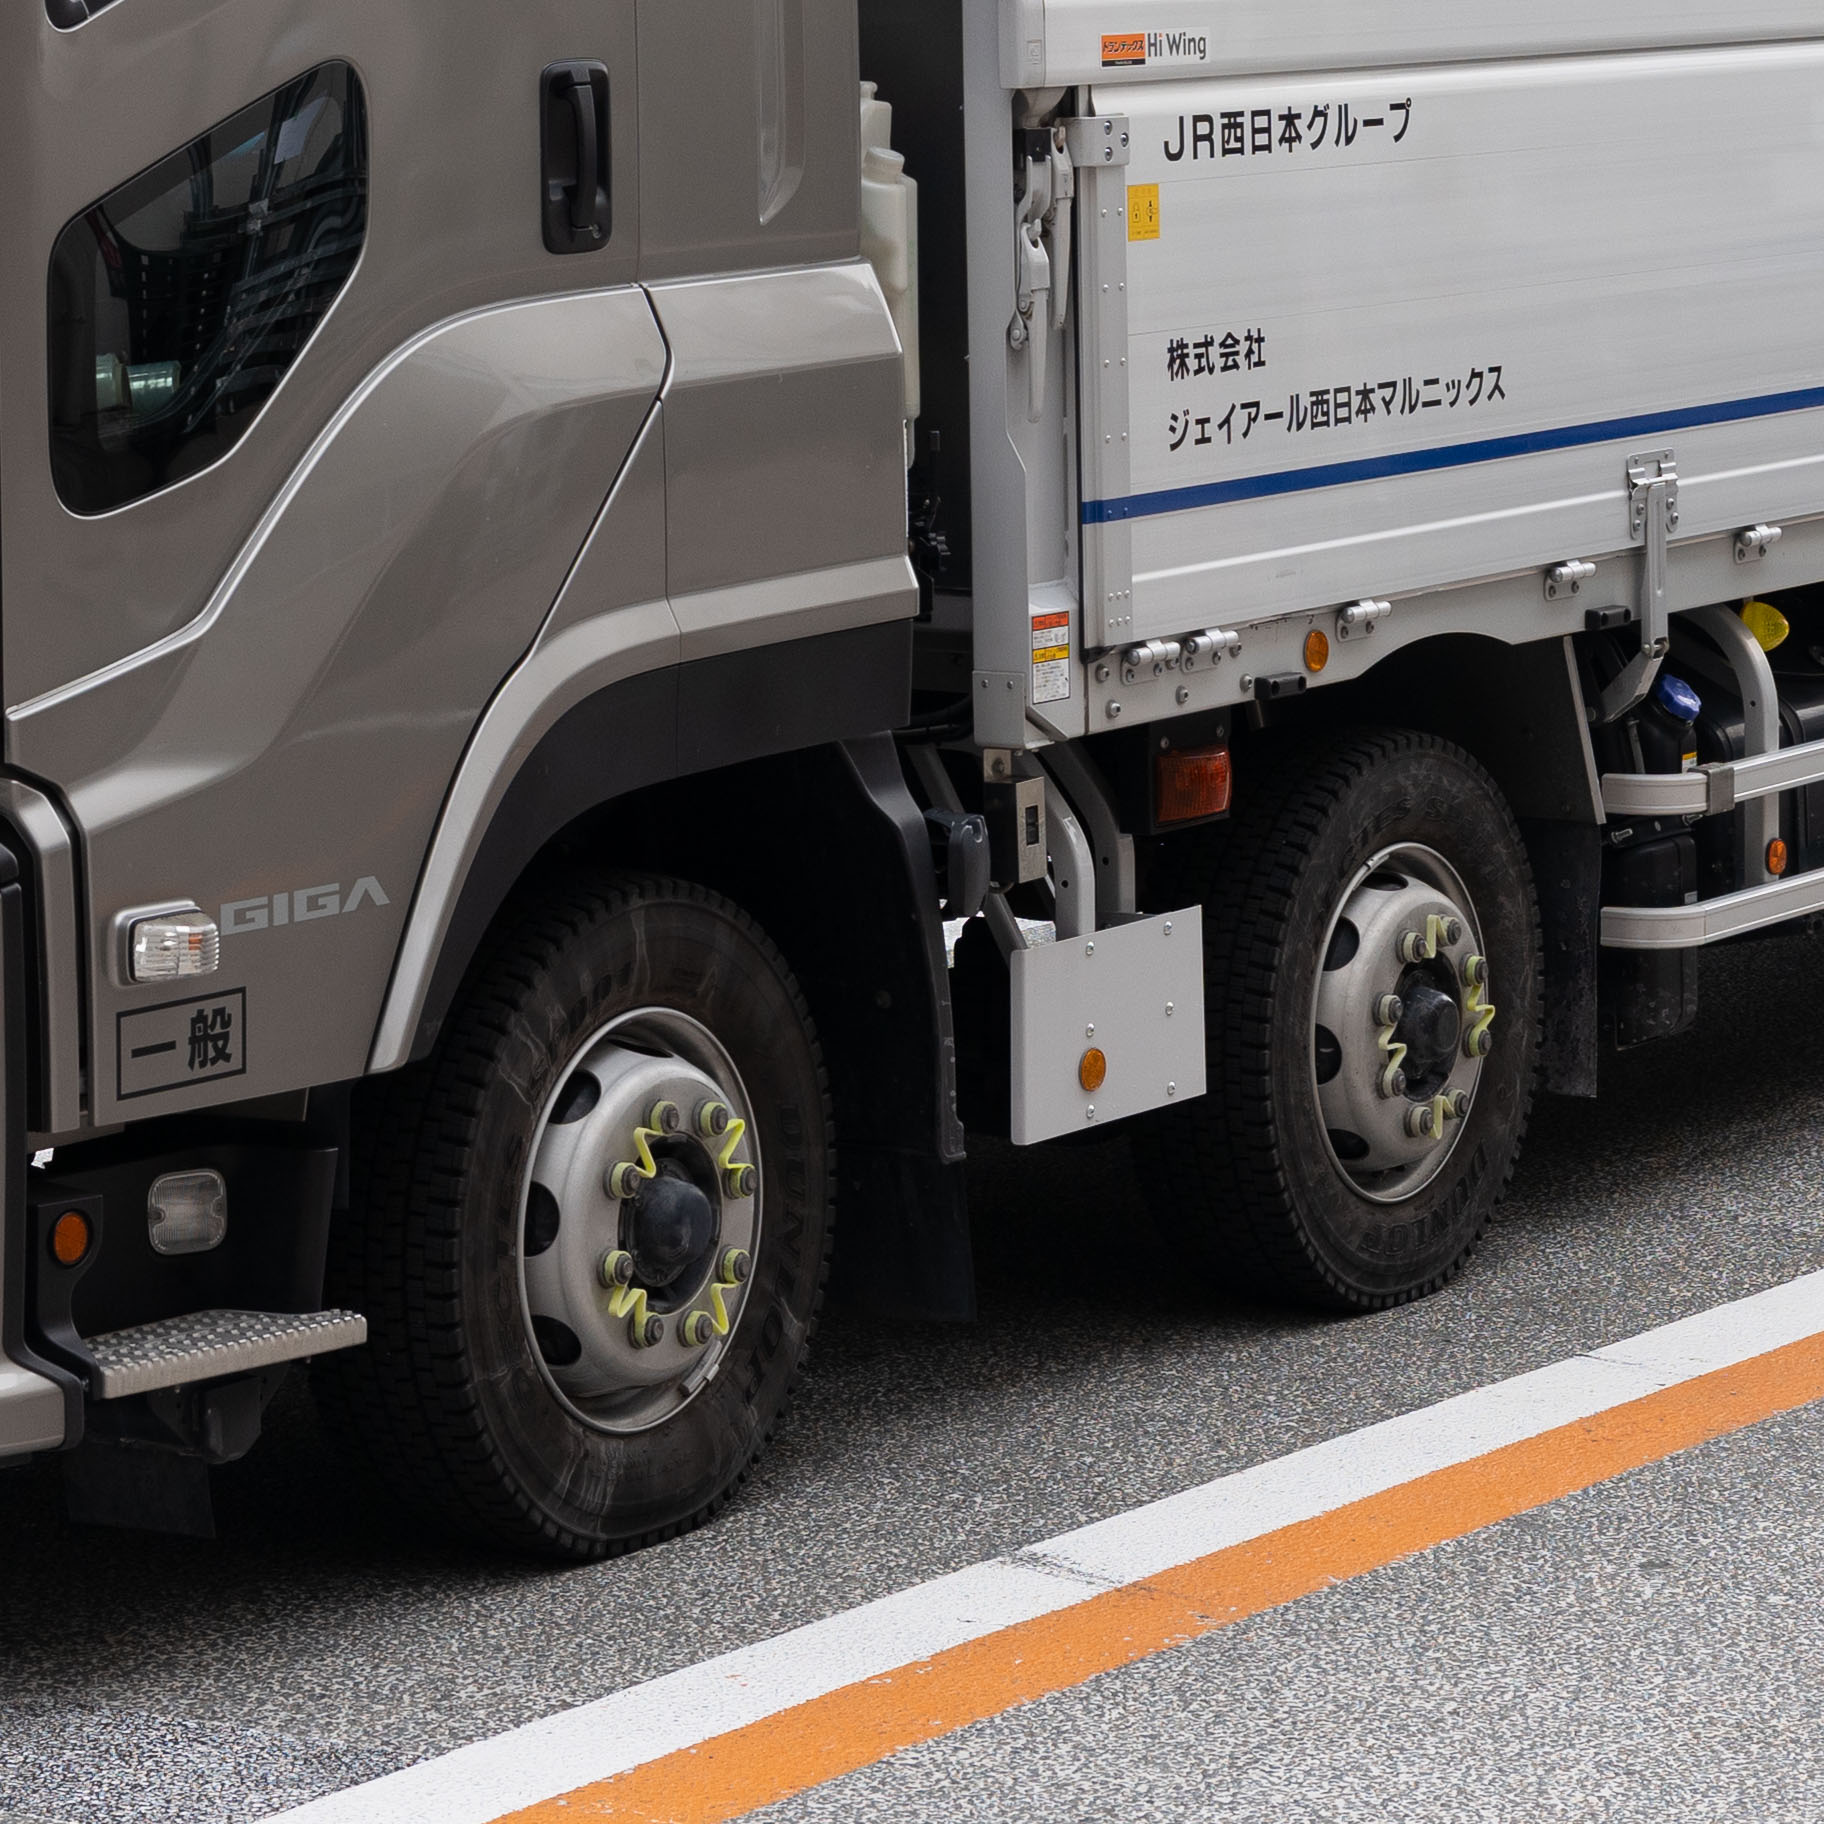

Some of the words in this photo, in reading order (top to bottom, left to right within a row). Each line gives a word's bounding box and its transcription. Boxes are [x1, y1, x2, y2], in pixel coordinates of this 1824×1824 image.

[1147, 32, 1163, 57] Hi
[1165, 32, 1207, 60] Wing
[1164, 97, 1413, 162] JR西日本グループ
[1166, 327, 1267, 382] 株式会社
[1168, 364, 1506, 452] ジェイアール西日本マルニックス
[220, 875, 391, 937] GIGA
[130, 1005, 233, 1072] 一般
